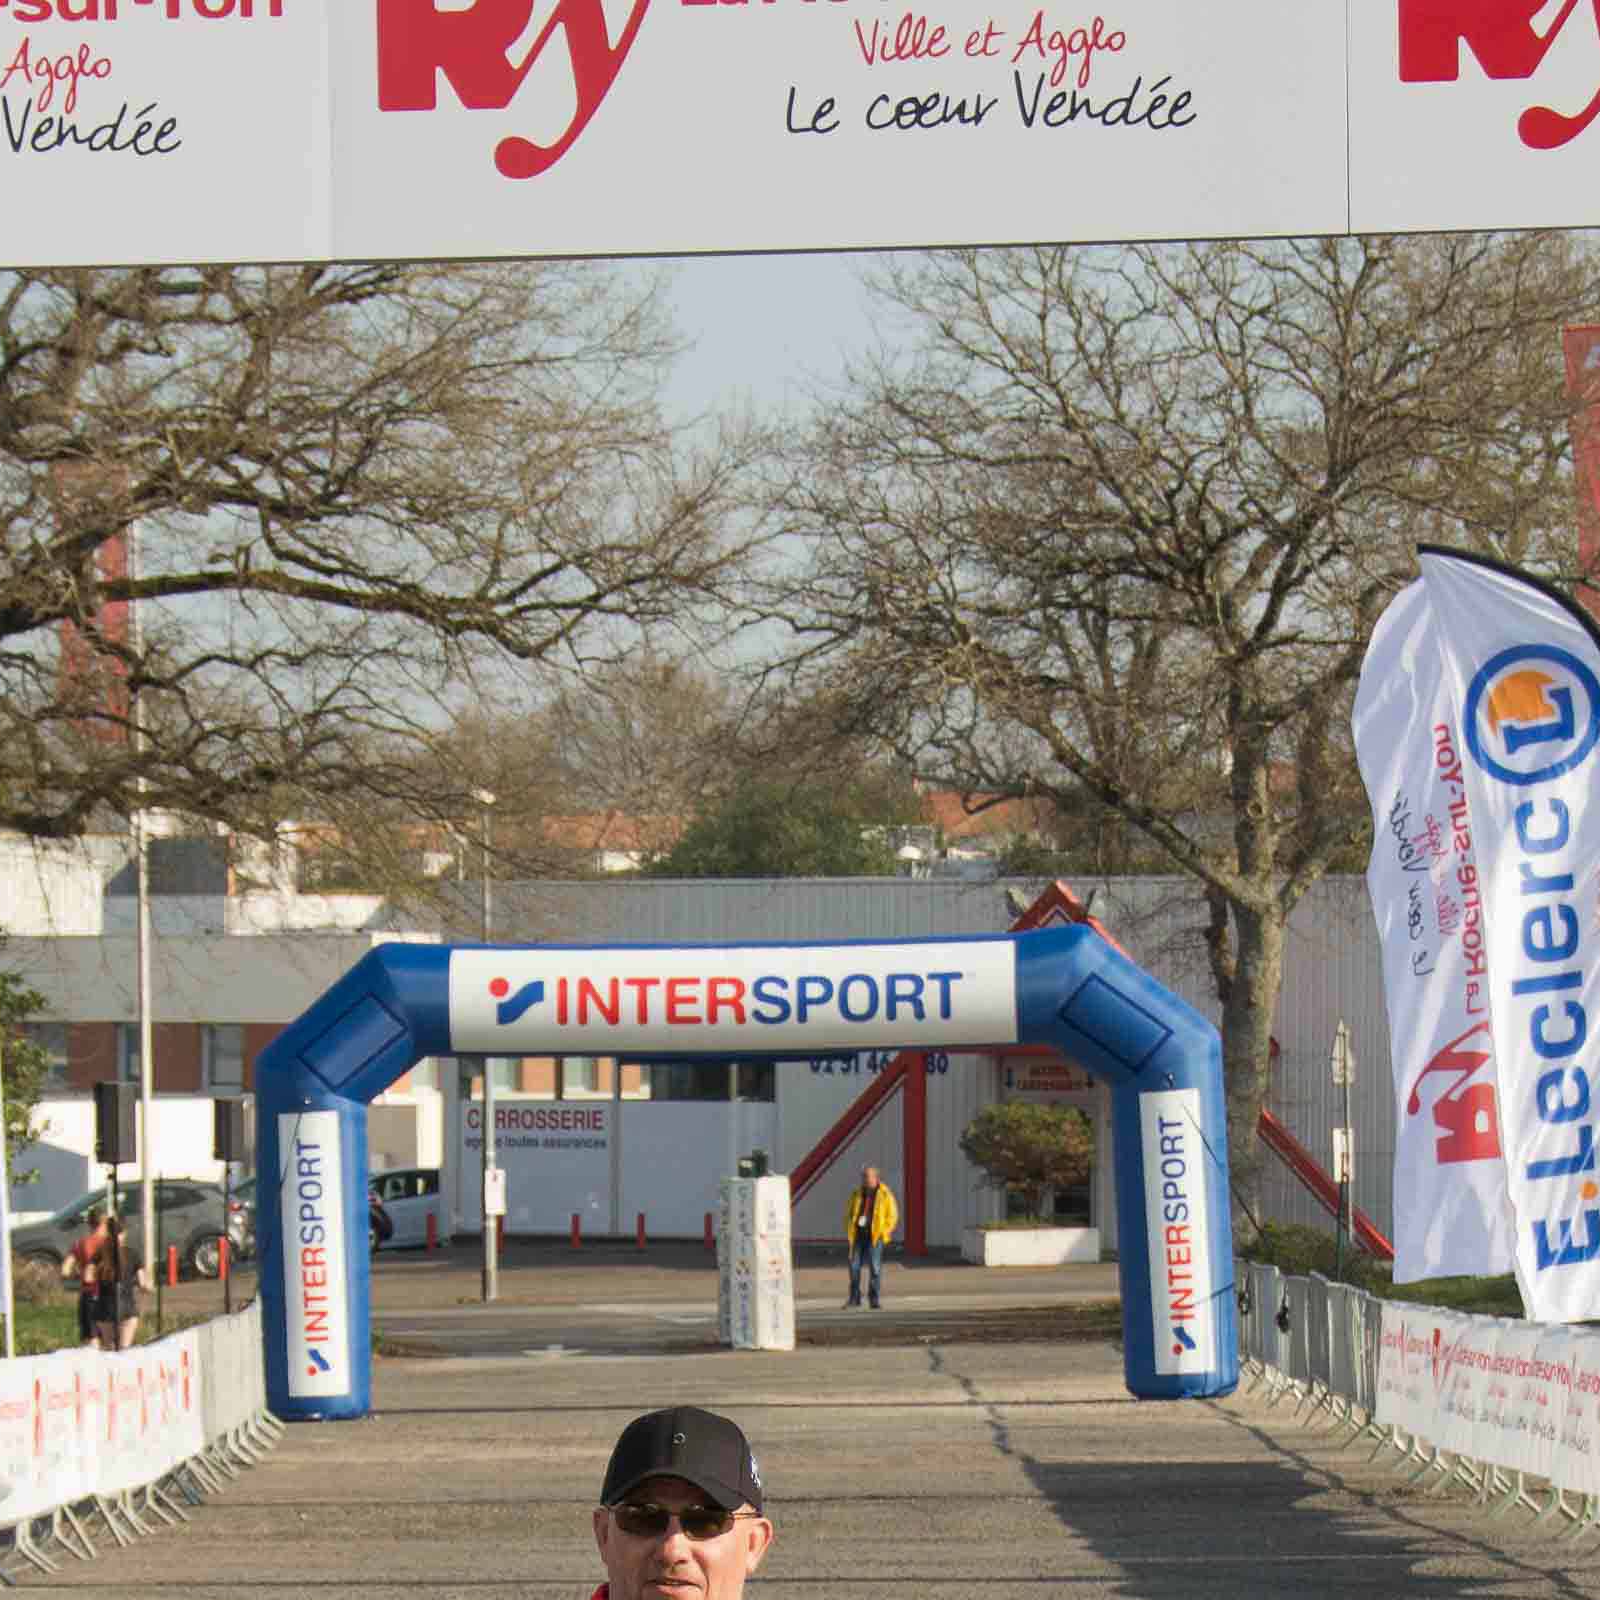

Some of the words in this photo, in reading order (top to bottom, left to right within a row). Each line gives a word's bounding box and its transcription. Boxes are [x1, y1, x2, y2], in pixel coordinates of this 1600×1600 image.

[0, 36, 112, 114] Agglo
[855, 17, 952, 65] Ville
[963, 22, 1006, 61] et
[1010, 10, 1127, 88] Agglo
[1, 95, 183, 157] Vendée
[786, 84, 840, 134] Le
[1012, 69, 1198, 132] Vendée
[556, 971, 964, 1027] INTERSPORT
[466, 1107, 606, 1130] CRROSSERIE
[296, 1136, 330, 1344] INTERSPORT
[1157, 1112, 1198, 1324] INTERSPORT
